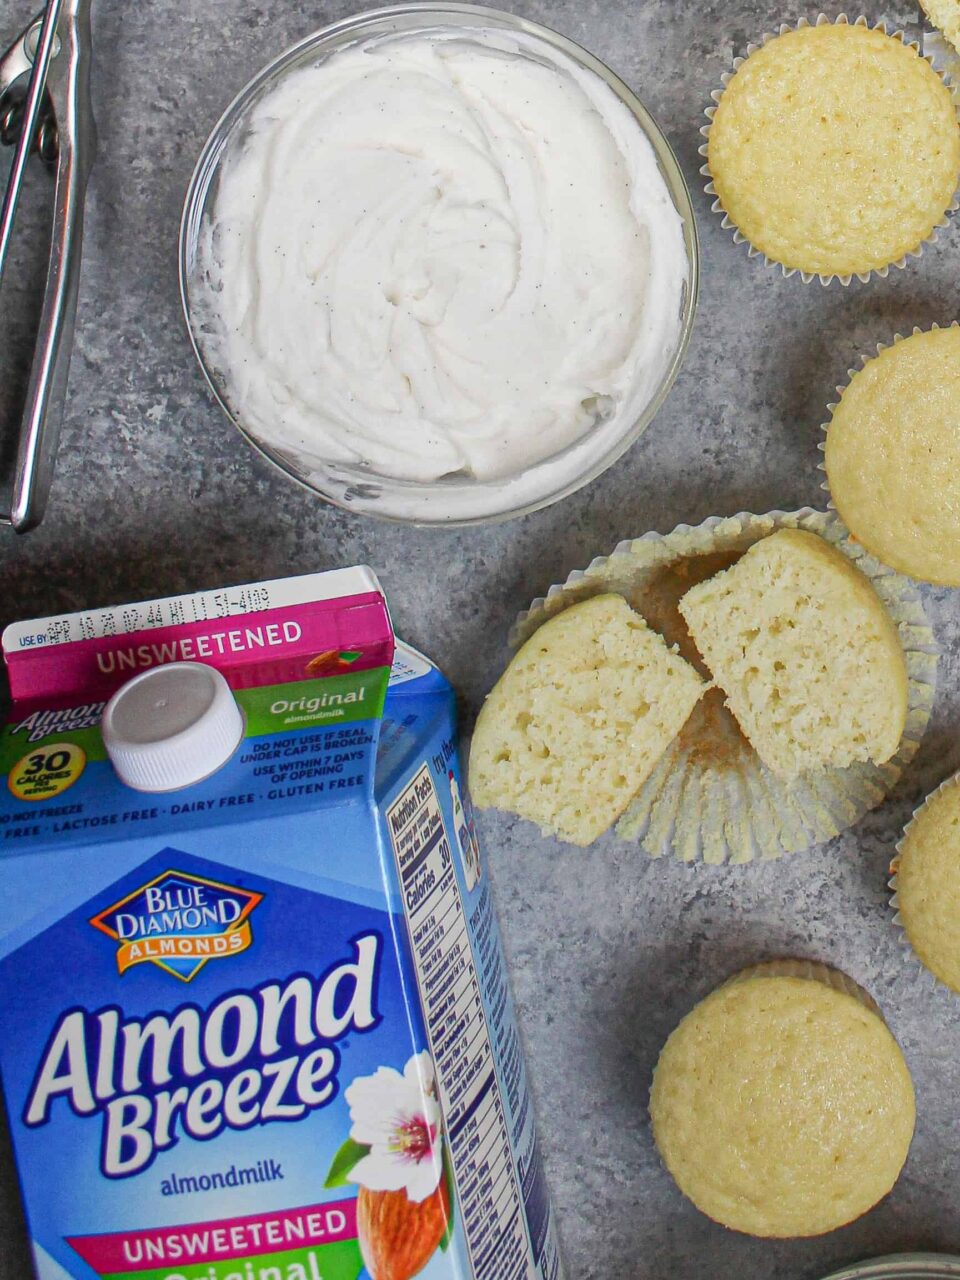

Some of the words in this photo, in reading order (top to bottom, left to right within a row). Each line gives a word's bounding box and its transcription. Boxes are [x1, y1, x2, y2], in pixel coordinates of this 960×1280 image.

[19, 635, 36, 647] USE
[36, 633, 47, 644] BY
[96, 621, 302, 673] UNSWEETENED
[270, 687, 365, 715] Original
[12, 702, 106, 734] Almon
[284, 708, 345, 724] almondmilk
[240, 749, 281, 764] UNDER
[283, 744, 310, 758] CAP
[310, 742, 322, 753] IS
[323, 735, 377, 752] BROKEN.
[253, 741, 270, 754] DO
[271, 737, 299, 752] NOT
[299, 733, 322, 746] USE
[323, 731, 336, 743] IF
[337, 728, 367, 740] SEAL
[24, 751, 71, 775] 30
[253, 765, 277, 777] USE
[278, 758, 322, 774] WITHIN
[324, 756, 332, 767] 7
[332, 750, 366, 765] DAYS
[270, 772, 288, 785] OF
[289, 763, 344, 781] OPENING
[16, 770, 72, 786] CALORIES
[24, 785, 58, 796] SERVING
[34, 780, 50, 788] PER
[5, 825, 41, 839] FREE
[53, 815, 119, 833] LACTOSE
[122, 808, 159, 823] FREE
[170, 799, 217, 815] DAIRY
[218, 793, 255, 810] FREE
[267, 782, 324, 801] GLUTEN
[328, 774, 365, 791] FREE
[13, 808, 38, 822] NOT
[39, 804, 84, 818] FREEZE
[391, 787, 417, 836] Nutrition
[414, 769, 432, 807] Facts
[405, 860, 435, 914] Calories
[438, 836, 450, 871] 30
[145, 886, 205, 914] BLUE
[115, 898, 242, 939] DIAMOND
[127, 932, 244, 960] ALMONDS
[25, 935, 378, 1125] Almond
[103, 1047, 336, 1175] Breeze
[161, 1160, 284, 1197] almondmilk
[124, 1209, 347, 1263] UNSWEETENED
